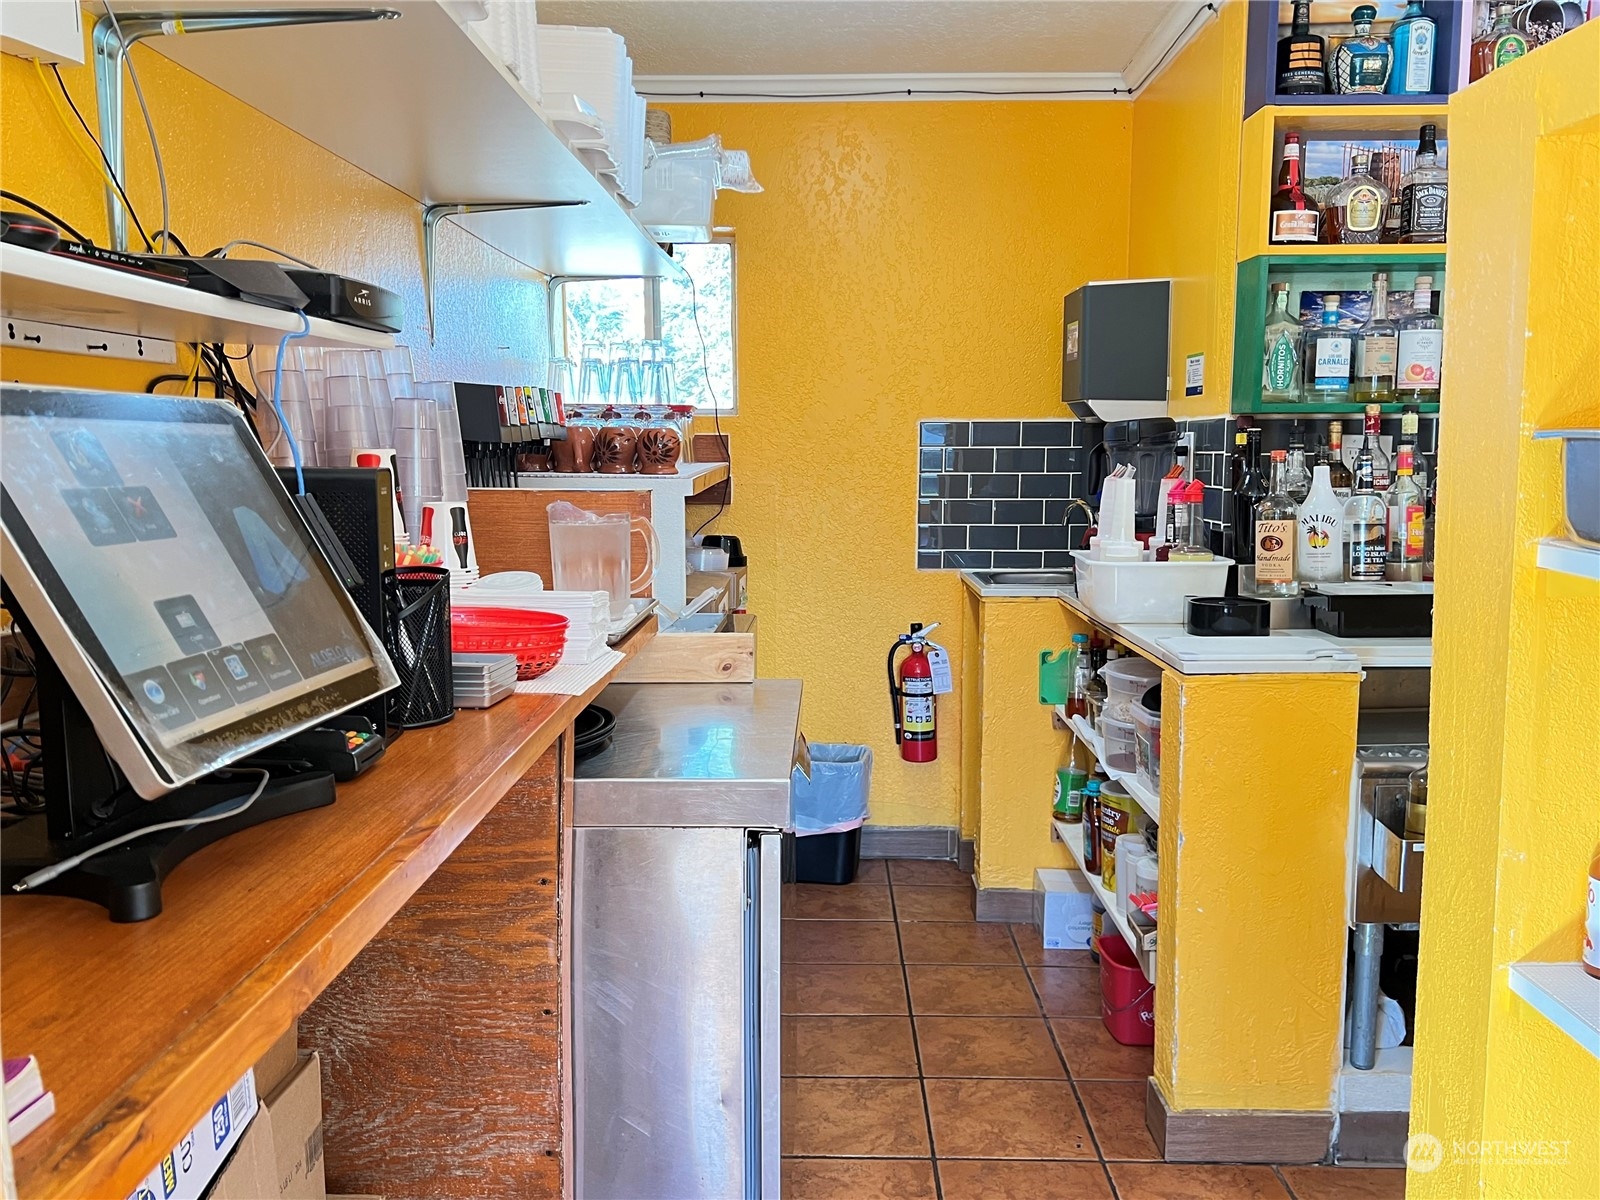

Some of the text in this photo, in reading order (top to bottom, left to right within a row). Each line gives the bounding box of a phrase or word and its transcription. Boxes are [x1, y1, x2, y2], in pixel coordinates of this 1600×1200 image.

[353, 296, 372, 306] ARRIS
[1276, 344, 1286, 387] HORNITOS
[1317, 358, 1349, 366] CARNALES
[1301, 514, 1338, 528] MALIBU
[1258, 522, 1288, 533] Tito's
[1256, 553, 1291, 562] Handmade
[214, 1103, 227, 1144] 250
[163, 1153, 175, 1194] MED
